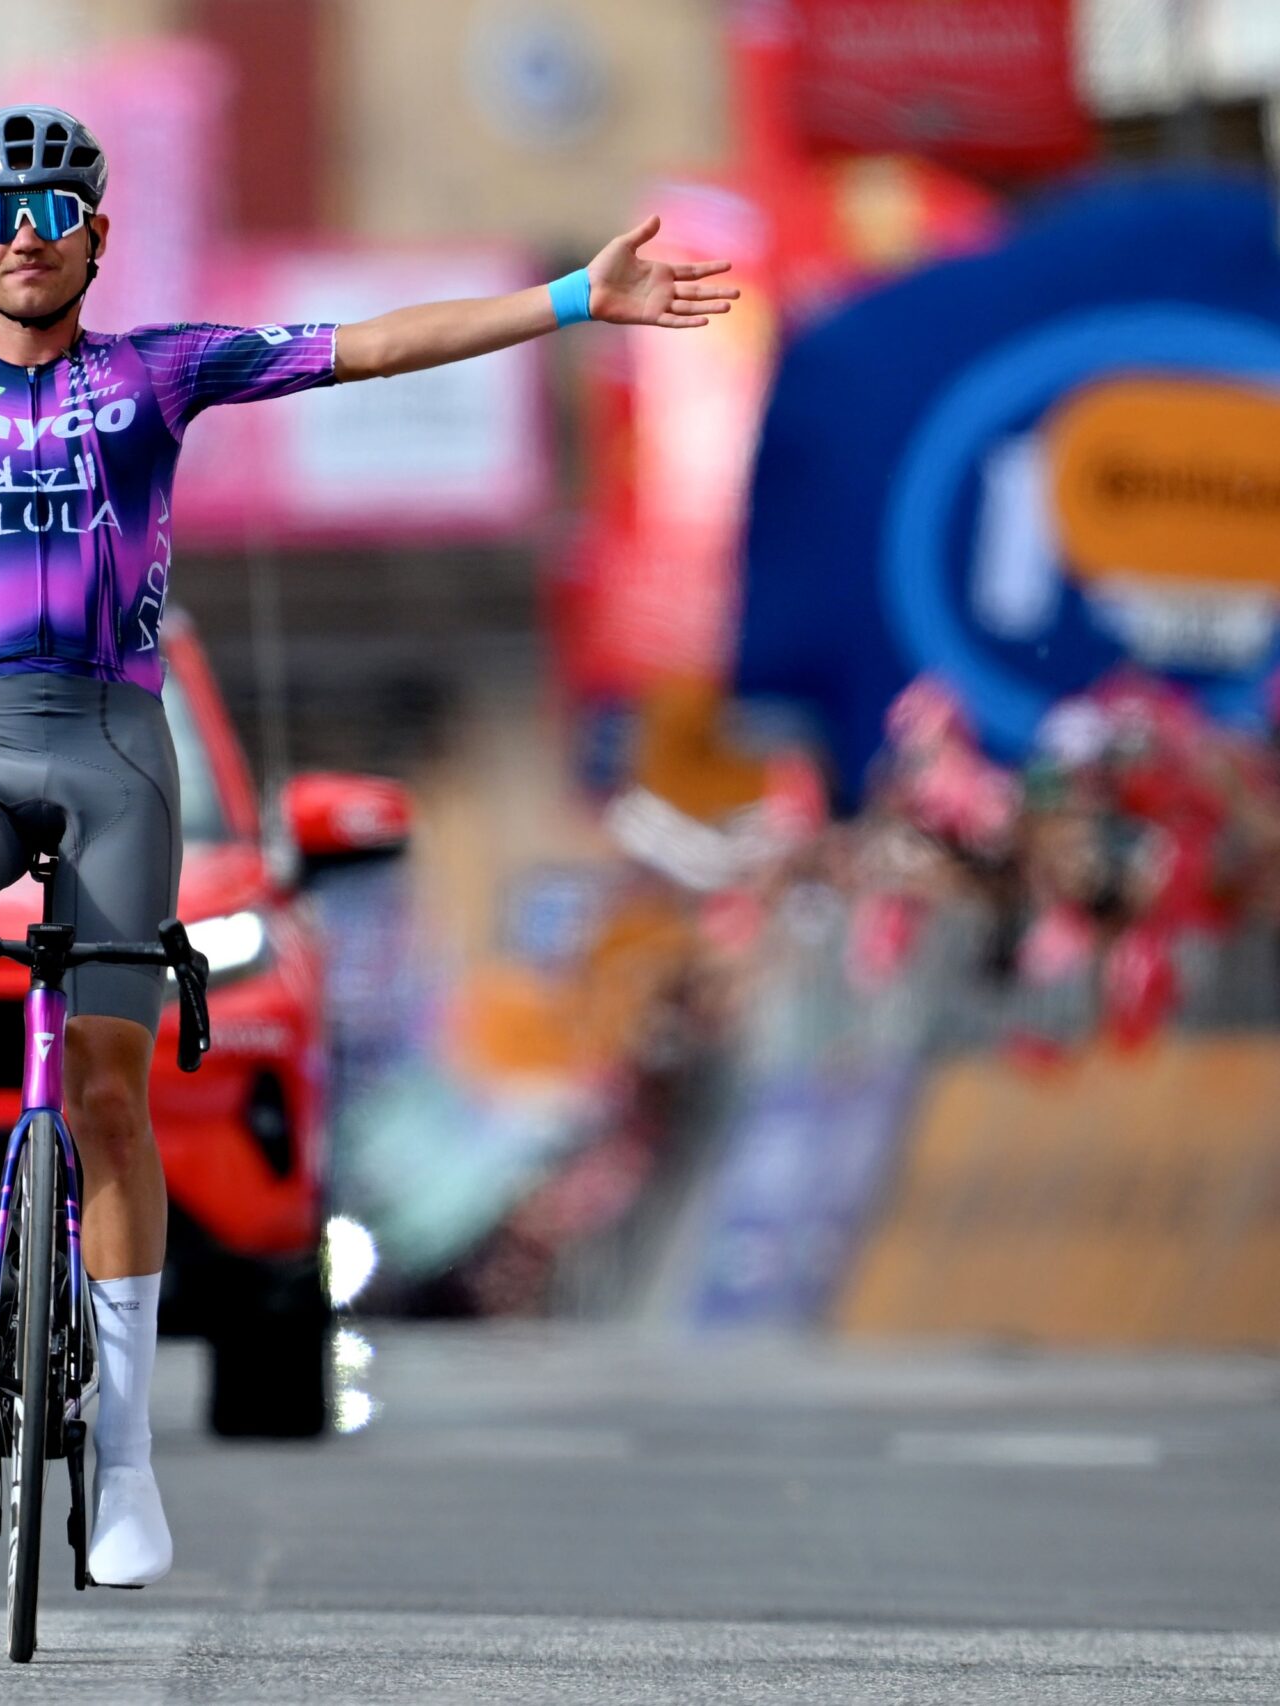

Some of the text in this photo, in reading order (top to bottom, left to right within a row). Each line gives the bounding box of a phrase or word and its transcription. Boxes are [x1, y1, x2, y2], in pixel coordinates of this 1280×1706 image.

[68, 357, 110, 378] MAAP
[68, 367, 112, 390] MAAP
[135, 487, 169, 652] ALULA
